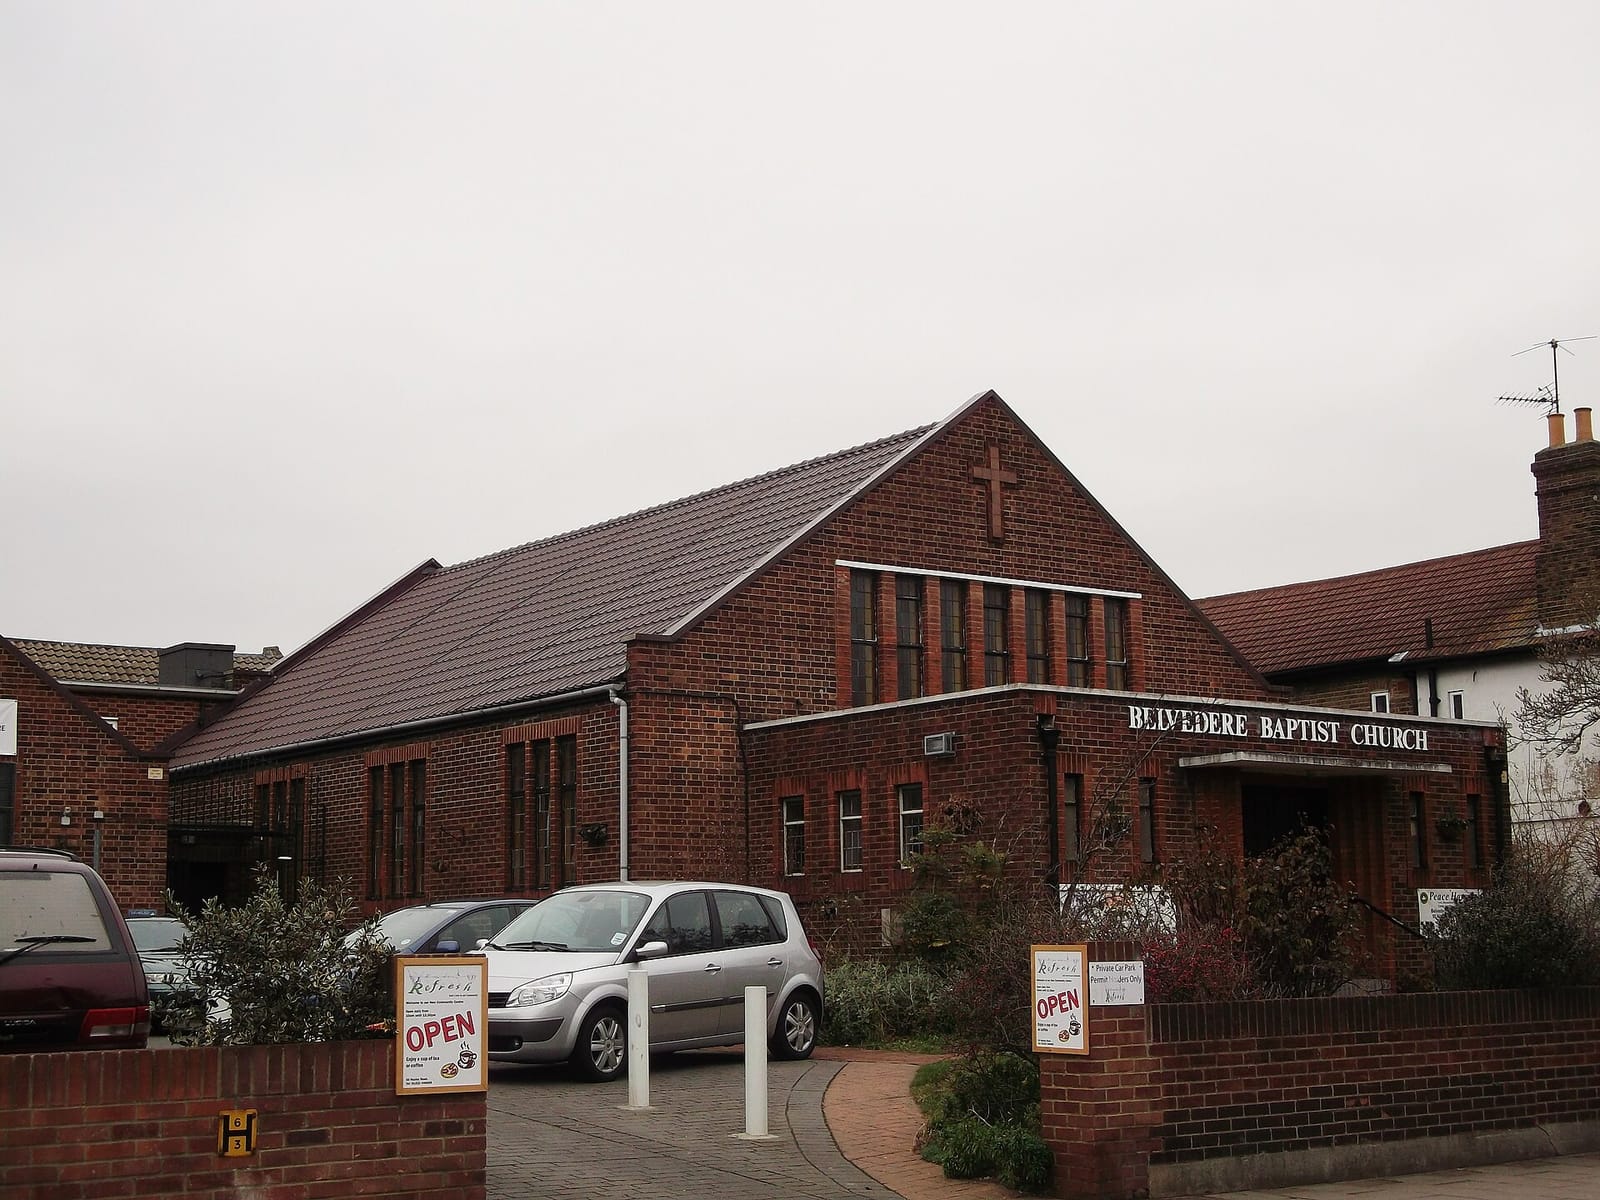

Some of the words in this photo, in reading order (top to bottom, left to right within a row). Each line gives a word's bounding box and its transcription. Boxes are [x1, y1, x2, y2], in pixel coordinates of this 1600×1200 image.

[1127, 705, 1249, 737] BELVEDERE
[1260, 716, 1340, 743] BAPTIST
[1350, 723, 1429, 751] CHURCH
[1429, 891, 1450, 901] Peace
[1096, 964, 1115, 972] Private
[1115, 963, 1124, 972] Car
[1125, 963, 1136, 971] Park
[408, 977, 473, 995] Refresh
[1130, 974, 1142, 984] Only
[1037, 988, 1080, 1019] OPEN
[406, 1010, 476, 1052] OPEN
[234, 1117, 241, 1127] 6
[223, 1113, 253, 1152] H
[234, 1139, 241, 1149] 3
